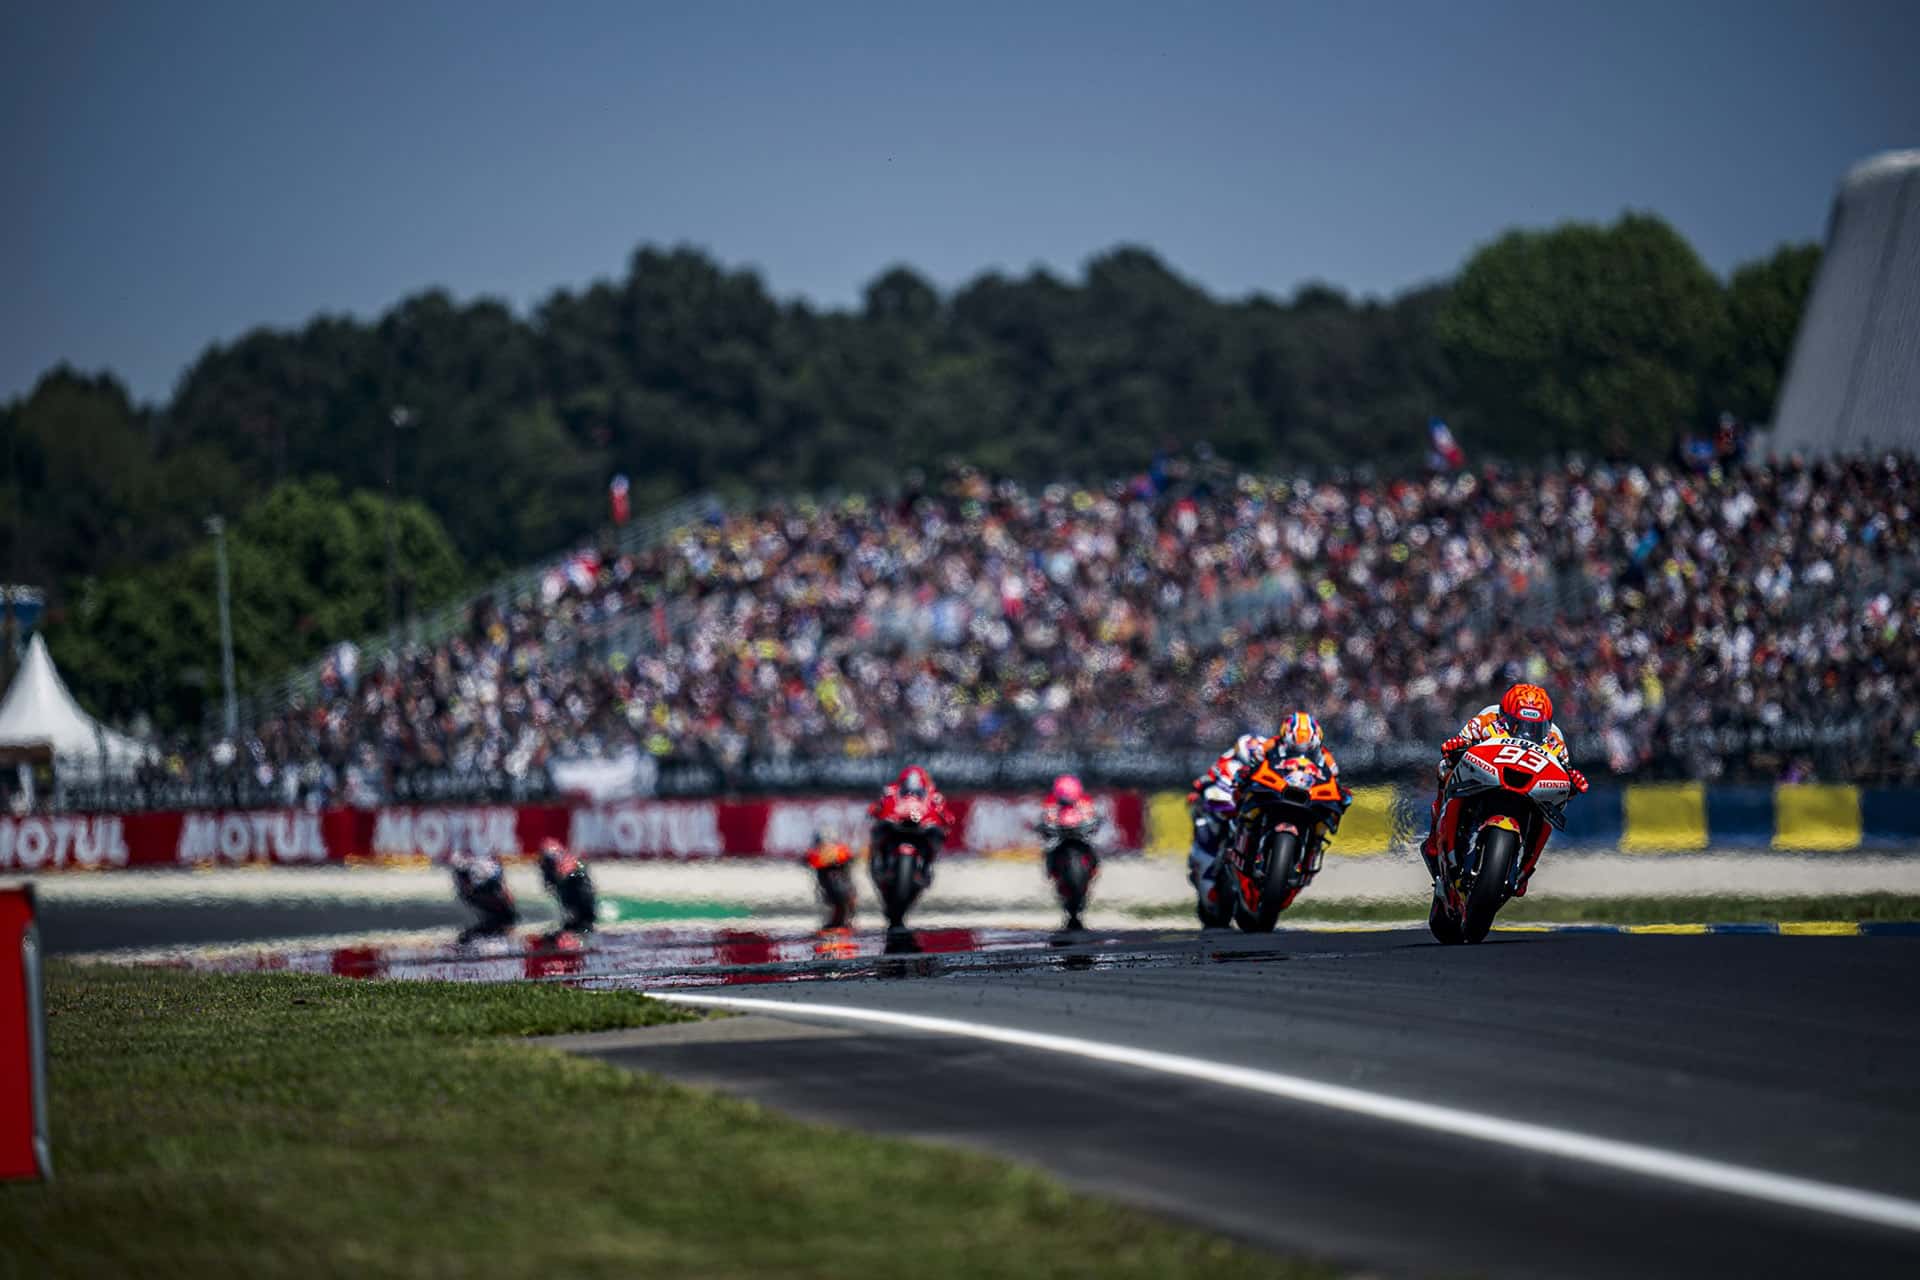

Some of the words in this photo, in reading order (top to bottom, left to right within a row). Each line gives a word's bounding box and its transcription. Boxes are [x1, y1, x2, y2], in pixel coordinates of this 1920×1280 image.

[1463, 753, 1497, 776] HONDA
[1493, 746, 1549, 773] 93
[1538, 781, 1570, 789] HONDA
[178, 812, 328, 864] MOTUL
